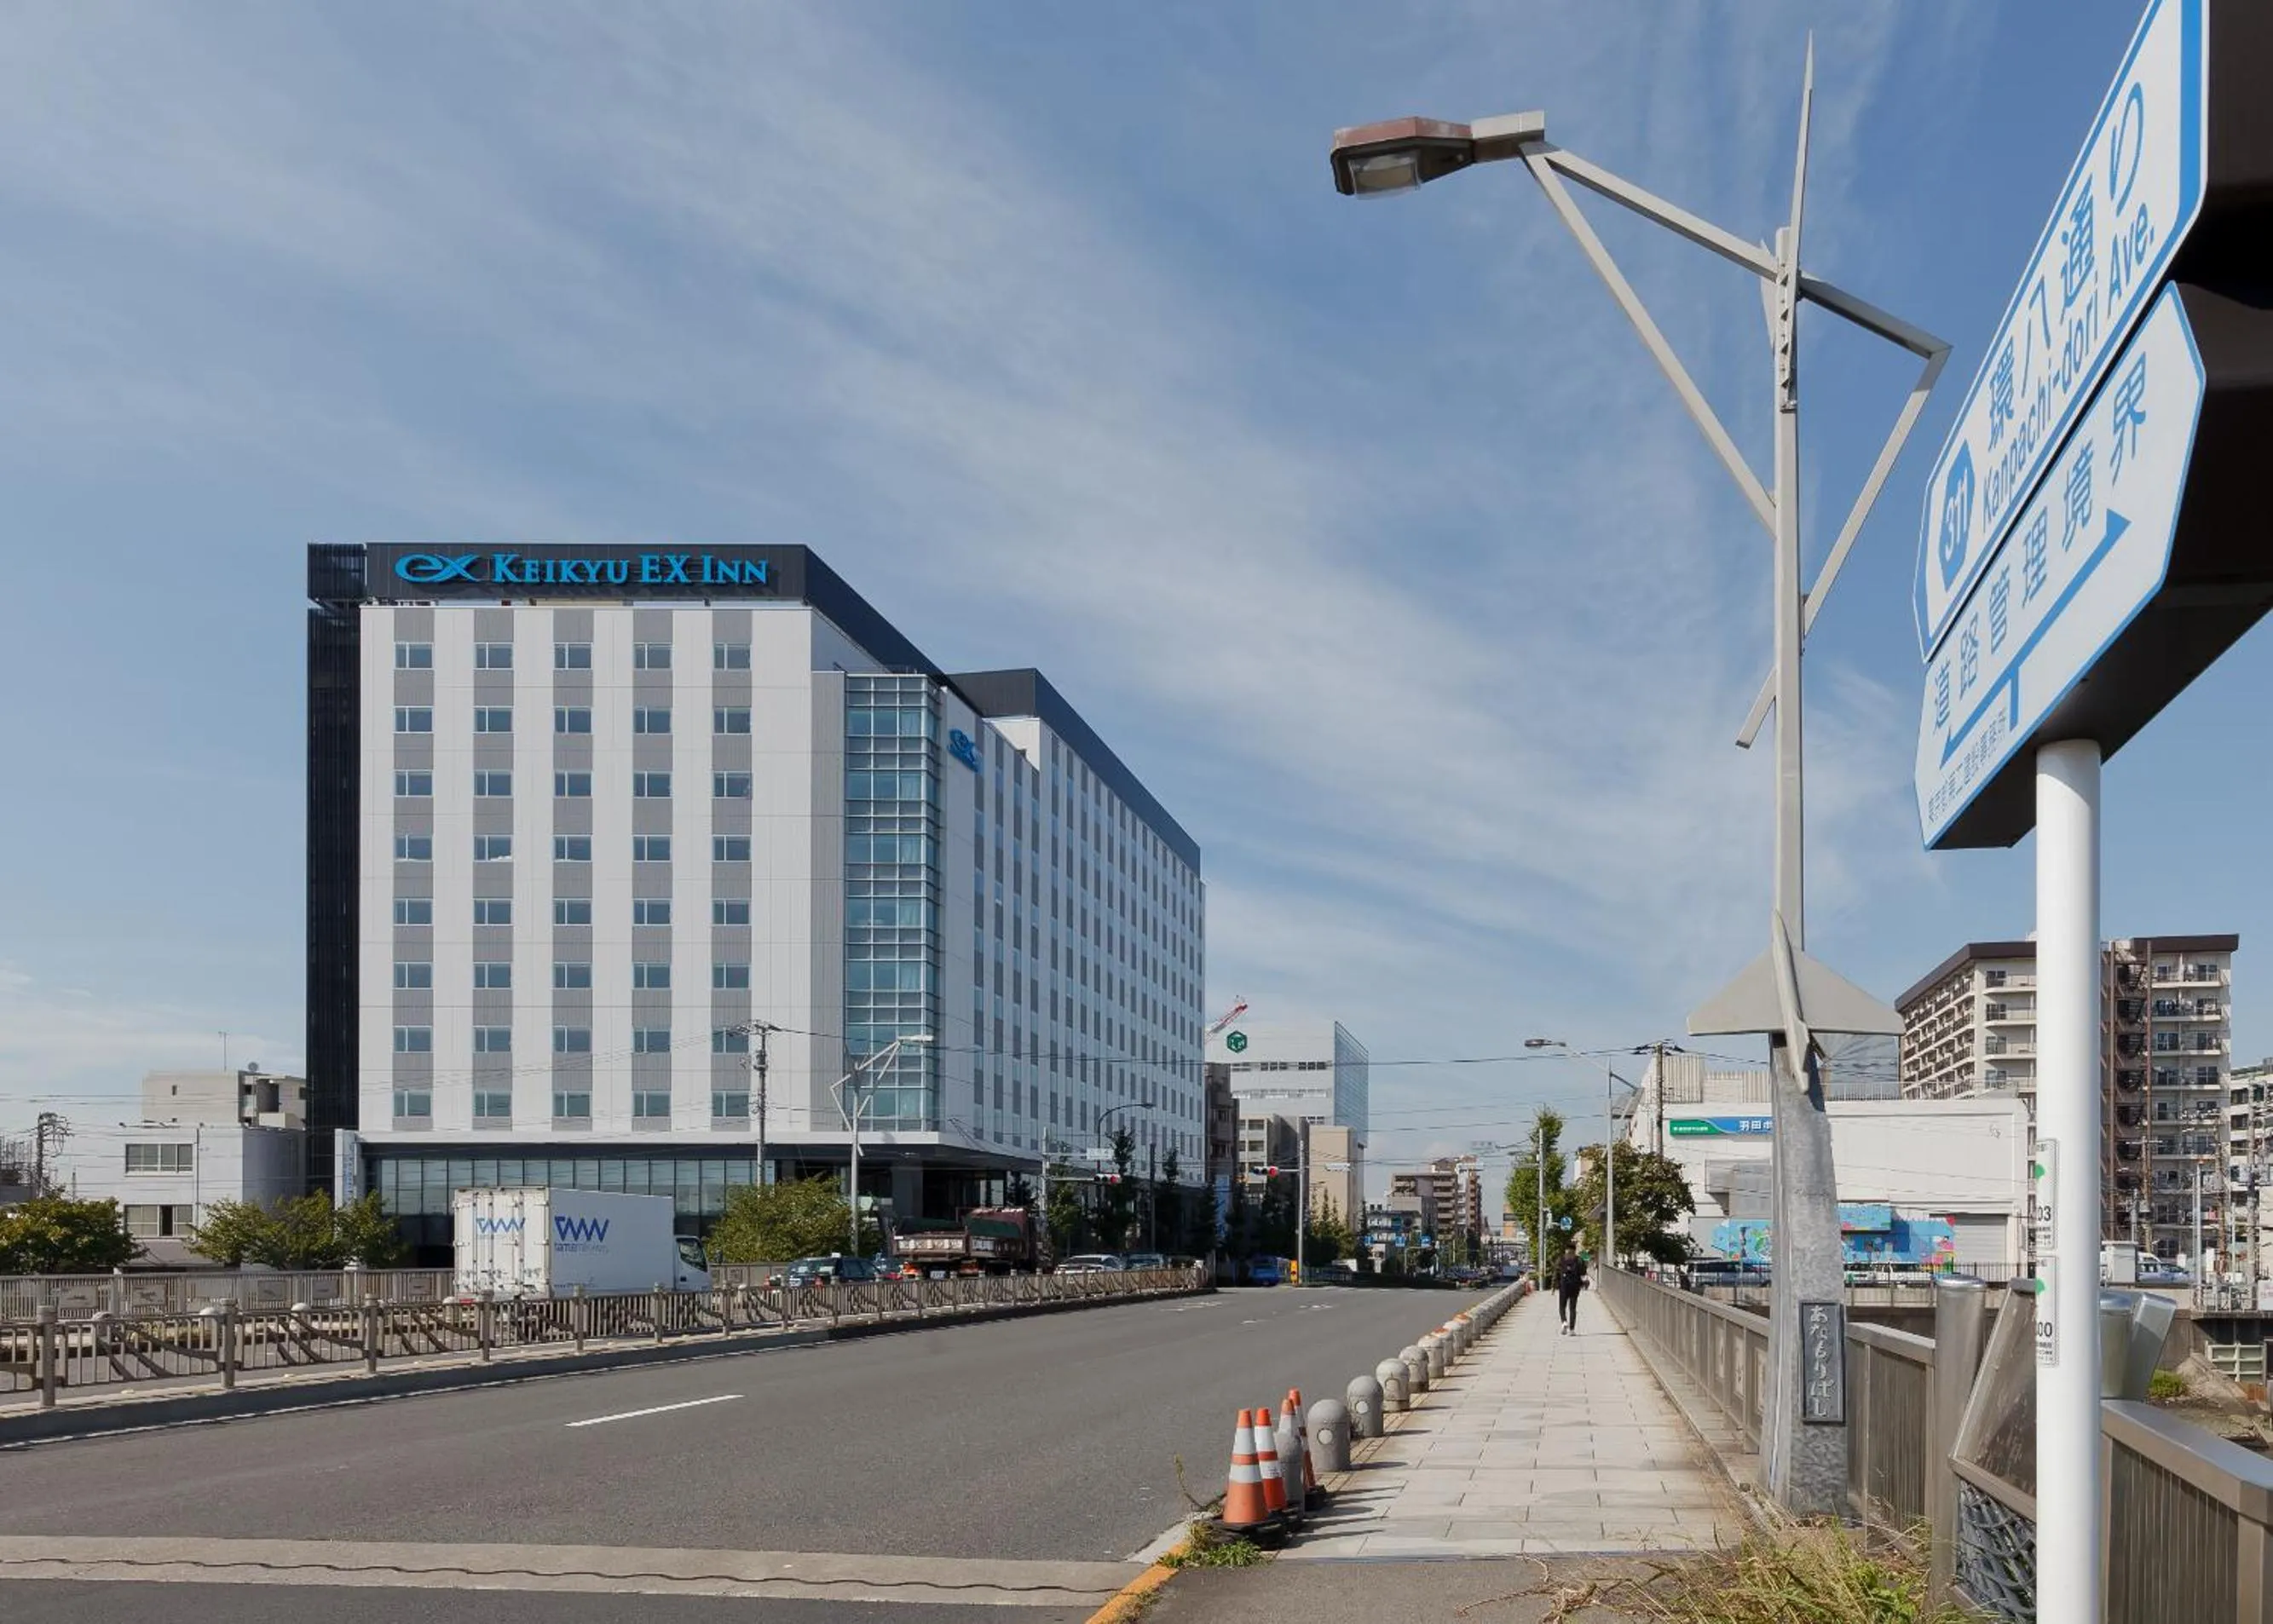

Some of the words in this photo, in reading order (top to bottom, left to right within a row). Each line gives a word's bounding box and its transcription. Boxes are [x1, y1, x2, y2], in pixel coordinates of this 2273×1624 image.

[1982, 270, 2099, 534] Kanpachi-dori
[2108, 202, 2155, 318] Ave.
[1988, 82, 2144, 452] 環八通り
[491, 553, 630, 585] KEIKYU
[638, 553, 691, 584] EX
[701, 554, 768, 585] INN
[1934, 350, 2147, 734] 道路管理境界
